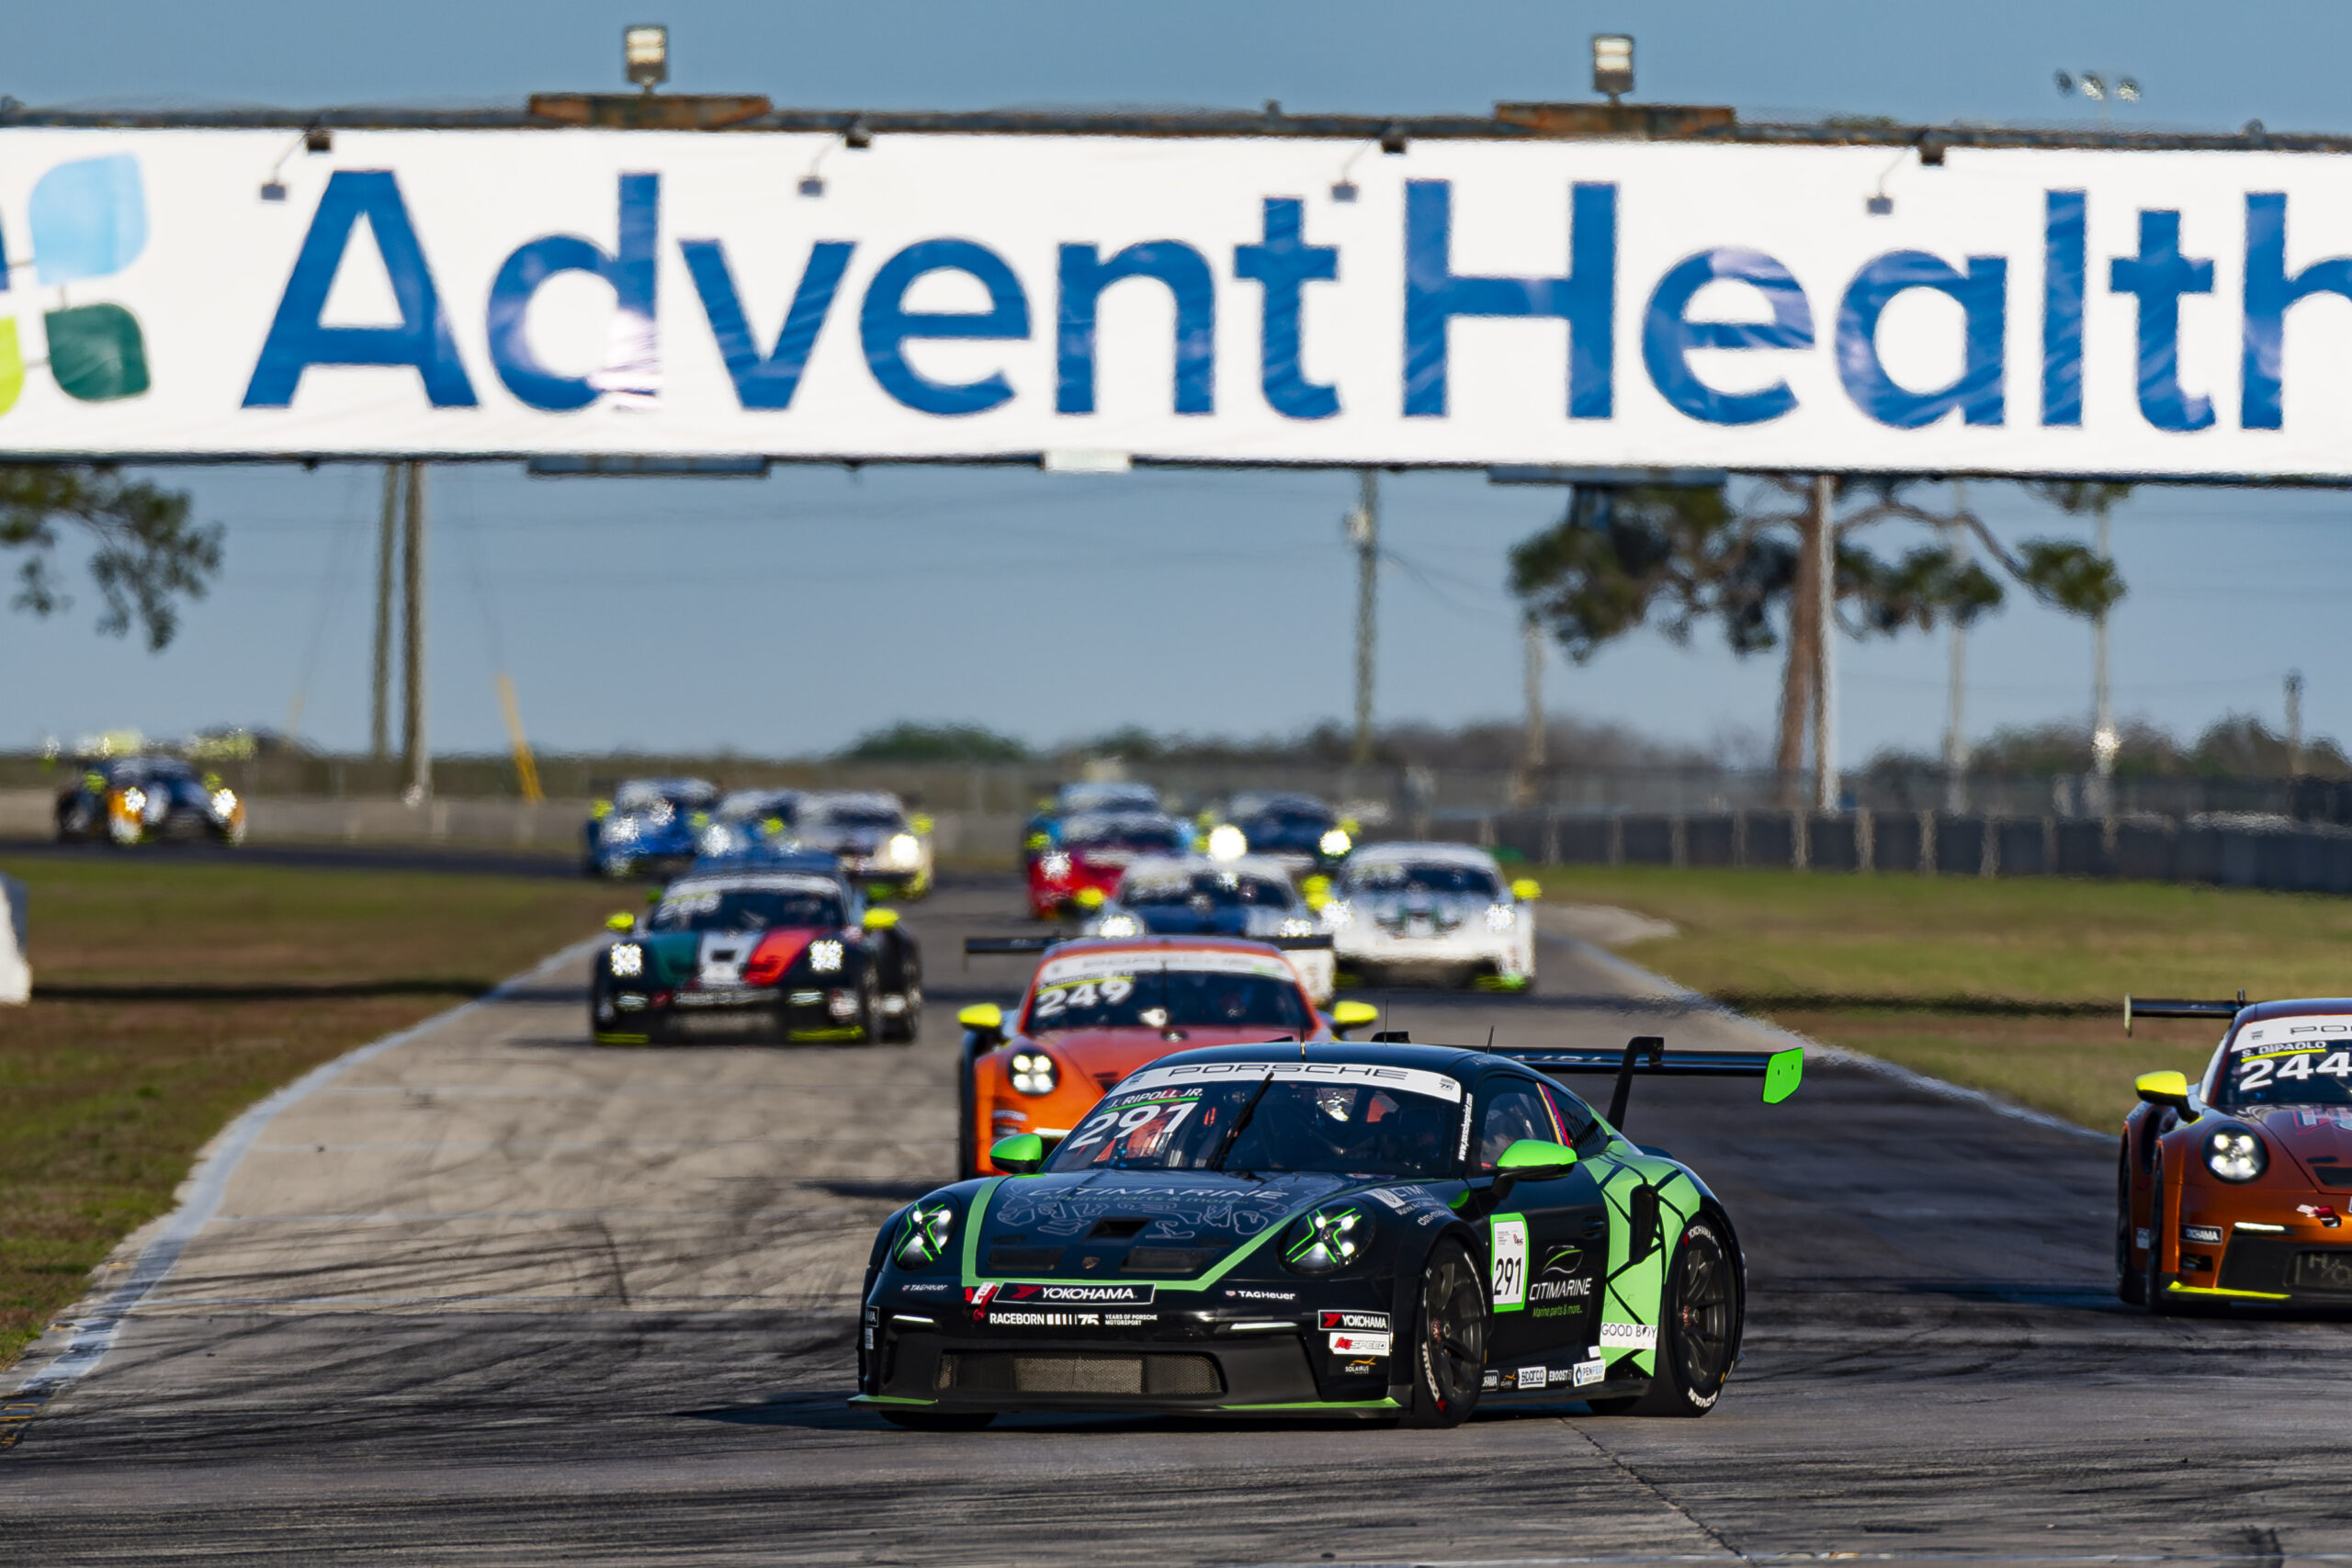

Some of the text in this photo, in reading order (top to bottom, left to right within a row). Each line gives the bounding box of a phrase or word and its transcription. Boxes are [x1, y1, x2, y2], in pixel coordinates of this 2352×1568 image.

[241, 169, 2352, 434] AdventHealth
[1036, 978, 1134, 1019] 249
[2258, 1041, 2327, 1055] DIPAOLO
[1168, 1064, 1408, 1080] PORSCHE
[2239, 1052, 2352, 1091] 244
[1122, 1089, 1178, 1105] RIPOLL
[1180, 1087, 1204, 1099] JR.
[1068, 1101, 1199, 1150] 291
[1028, 1187, 1289, 1200] CITIMARINE
[1494, 1258, 1522, 1296] 291
[1042, 1288, 1135, 1300] YOKOHAMA
[1529, 1278, 1593, 1301] CITIMARINE
[989, 1313, 1045, 1325] RACEBORN
[1077, 1314, 1100, 1325] 75
[1341, 1314, 1387, 1329] YOKOHAMA
[1601, 1323, 1633, 1337] GOOD
[1521, 1370, 1544, 1382] sparco
[1582, 1364, 1604, 1376] PENFED
[1688, 1386, 1718, 1407] ADVAN
